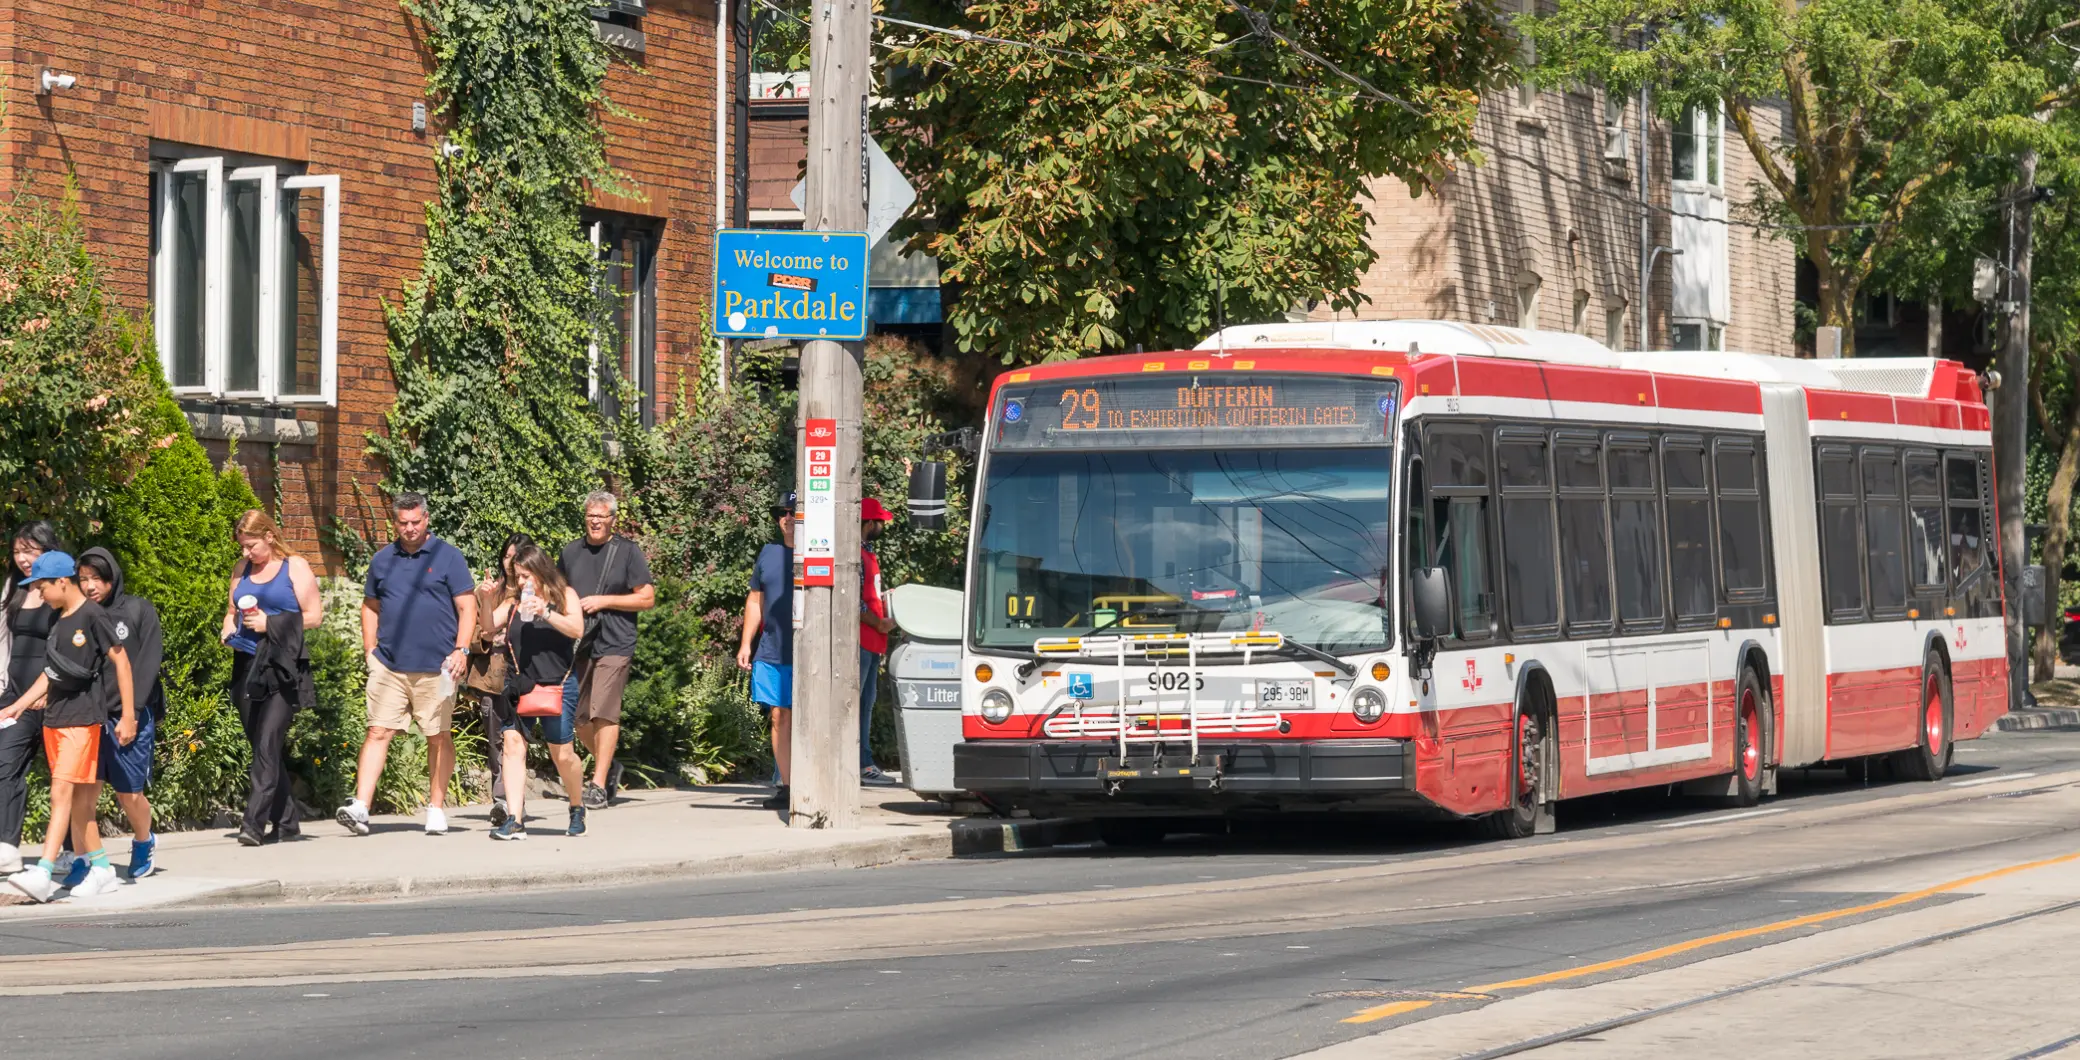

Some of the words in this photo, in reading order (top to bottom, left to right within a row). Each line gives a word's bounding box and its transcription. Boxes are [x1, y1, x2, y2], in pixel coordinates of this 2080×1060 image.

[734, 250, 823, 270] Welcome
[830, 254, 849, 270] to
[723, 290, 855, 321] Parkdale
[1177, 386, 1272, 408] DUFFERIN
[1061, 389, 1099, 429] 29
[1107, 410, 1124, 428] TO
[1130, 408, 1218, 428] EXHIBITION
[1314, 406, 1356, 425] GATE)
[815, 451, 826, 461] 29
[813, 466, 827, 475] 504
[1148, 672, 1204, 691] 9025
[927, 687, 959, 702] Litter
